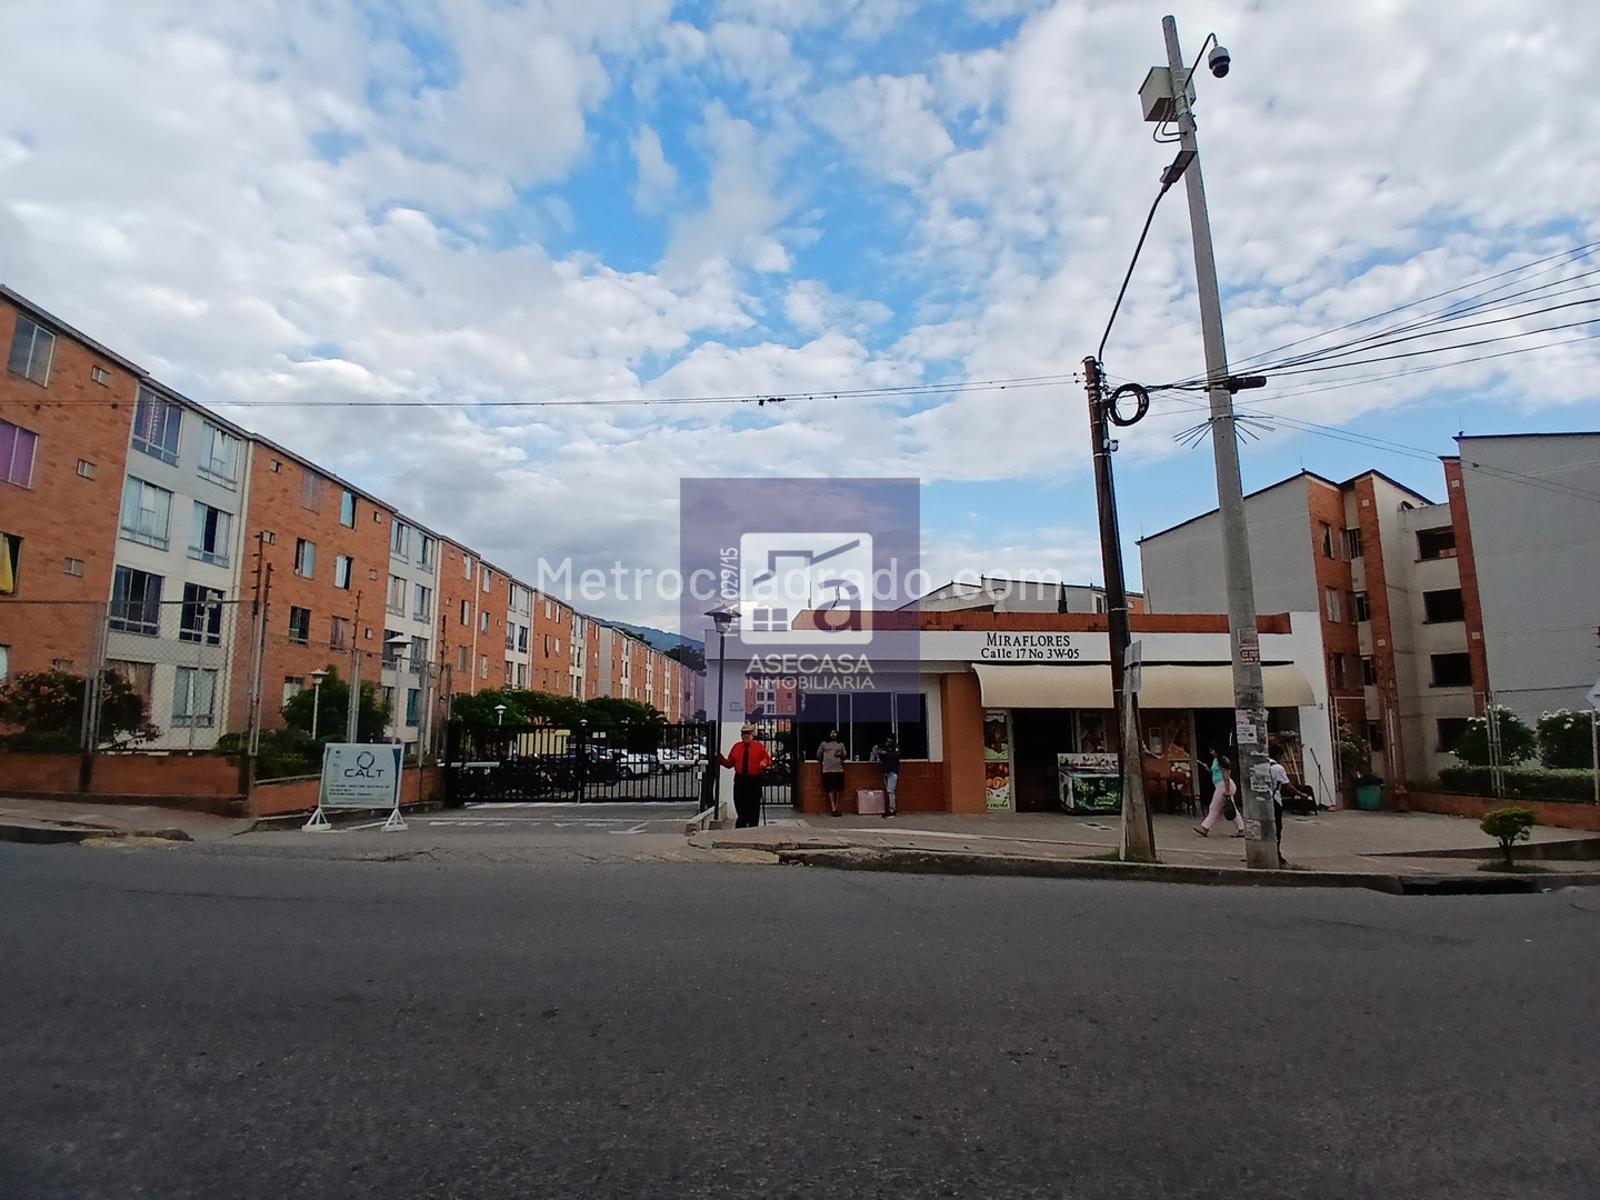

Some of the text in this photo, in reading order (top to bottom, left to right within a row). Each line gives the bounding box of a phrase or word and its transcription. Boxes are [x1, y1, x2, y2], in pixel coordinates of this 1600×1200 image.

[986, 632, 1071, 647] MIRAFLORES
[980, 647, 1012, 659] Calle
[1016, 648, 1026, 659] 17
[1029, 648, 1044, 659] No
[344, 768, 384, 778] CALT
